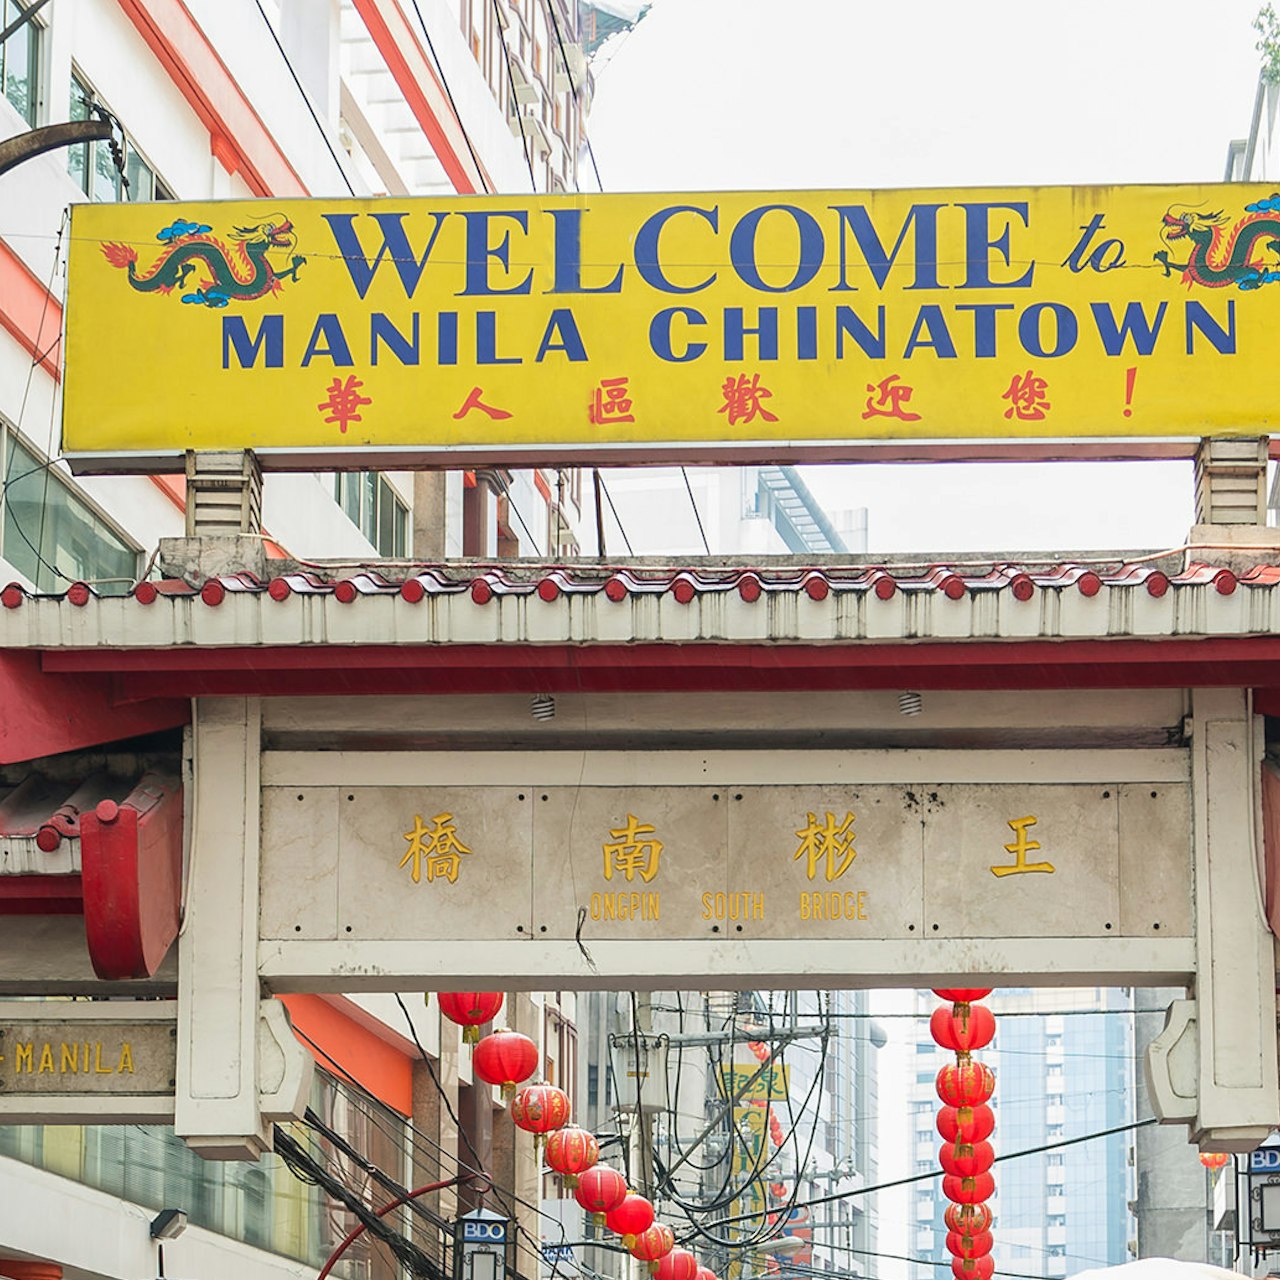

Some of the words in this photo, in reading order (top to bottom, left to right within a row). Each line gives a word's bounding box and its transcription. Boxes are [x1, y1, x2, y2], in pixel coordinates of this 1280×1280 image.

[322, 203, 1035, 300] WELCOME
[1061, 213, 1127, 273] to
[222, 308, 588, 369] MANILA
[649, 299, 1238, 363] CHINATOWN
[590, 891, 661, 921] ONGPIN
[701, 891, 765, 921] SOUTH
[799, 891, 868, 921] BRIDGE
[464, 1222, 505, 1240] BDO
